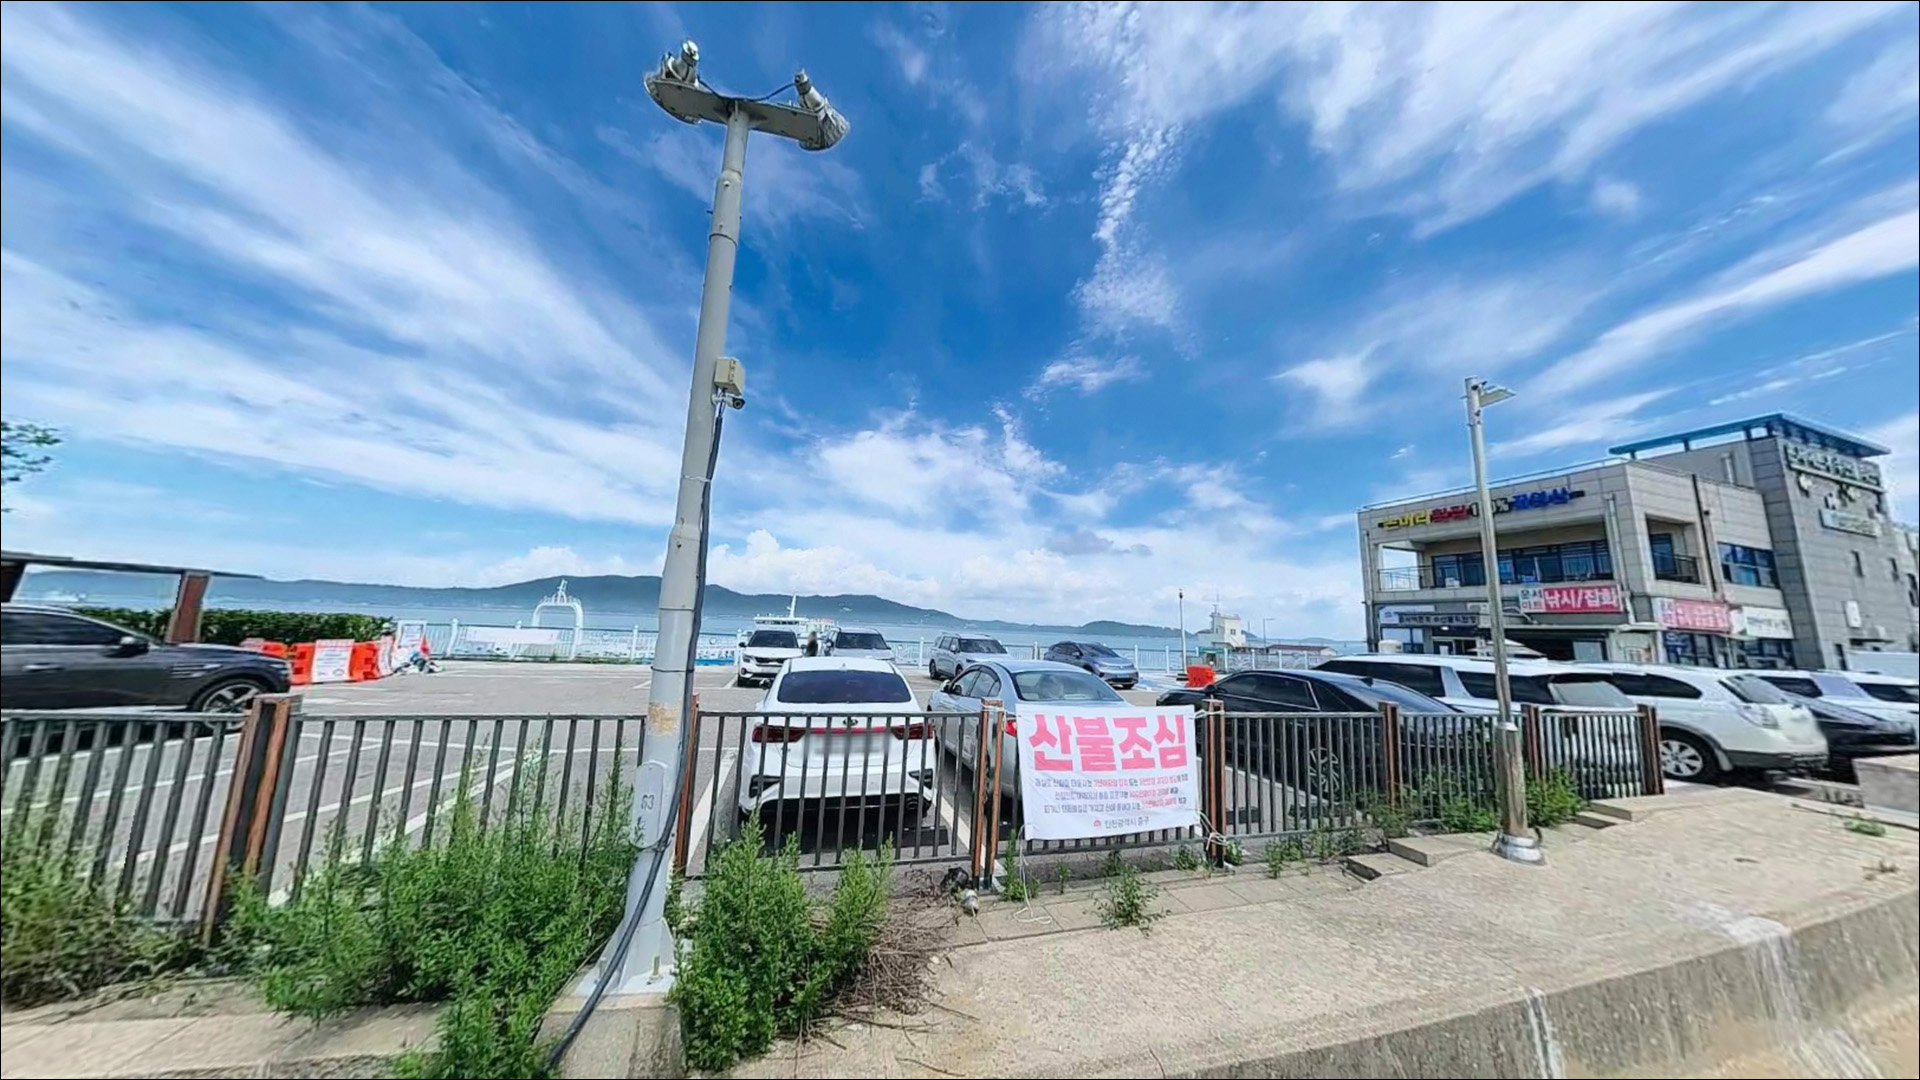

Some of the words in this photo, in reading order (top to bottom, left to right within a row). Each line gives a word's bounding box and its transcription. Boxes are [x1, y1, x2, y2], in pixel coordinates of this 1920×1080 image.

[1469, 498, 1510, 517] 10%
[1545, 588, 1618, 609] 낚시/잡화
[1028, 713, 1188, 772] 산불조심
[1105, 818, 1137, 829] 인천광역시
[1137, 816, 1149, 826] 중구
